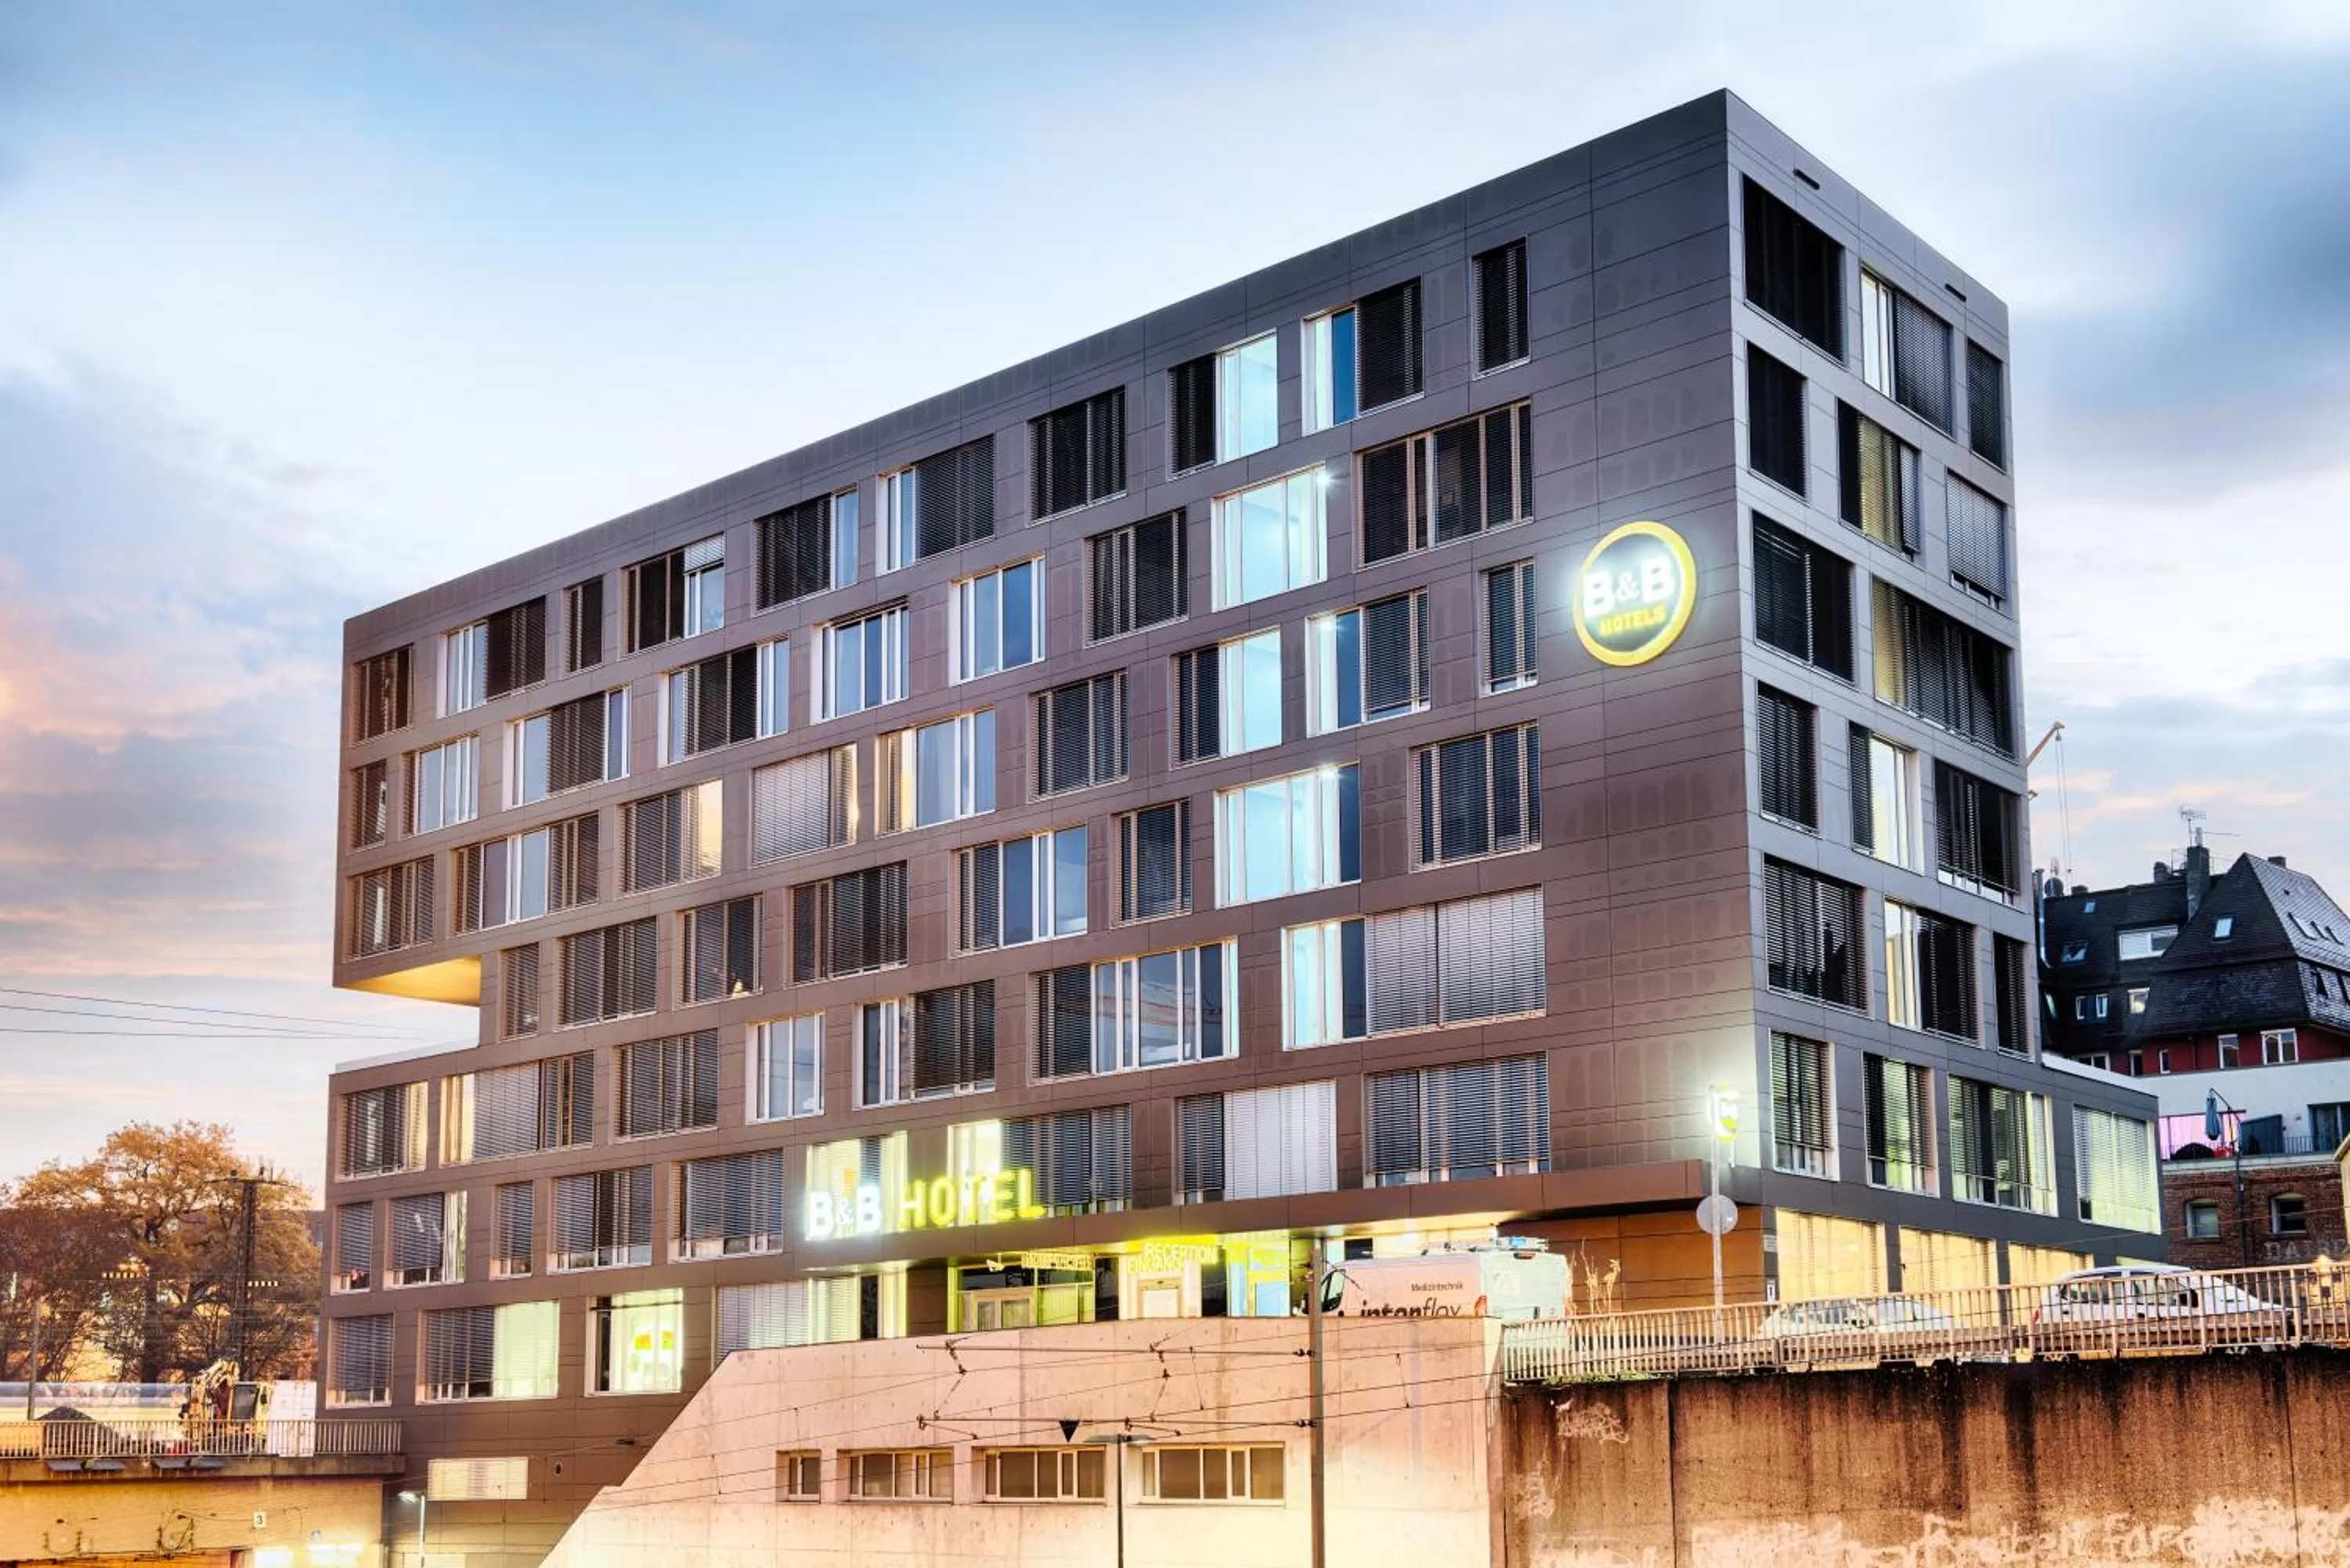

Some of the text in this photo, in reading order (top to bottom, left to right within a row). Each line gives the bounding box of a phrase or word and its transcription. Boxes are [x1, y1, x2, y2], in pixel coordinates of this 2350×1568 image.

[1582, 555, 1675, 617] B&B
[1599, 604, 1667, 638] HOTELS
[809, 1168, 1045, 1237] B&B HOTEL
[1143, 1242, 1218, 1265] RECEPTION
[256, 1514, 264, 1525] 3
